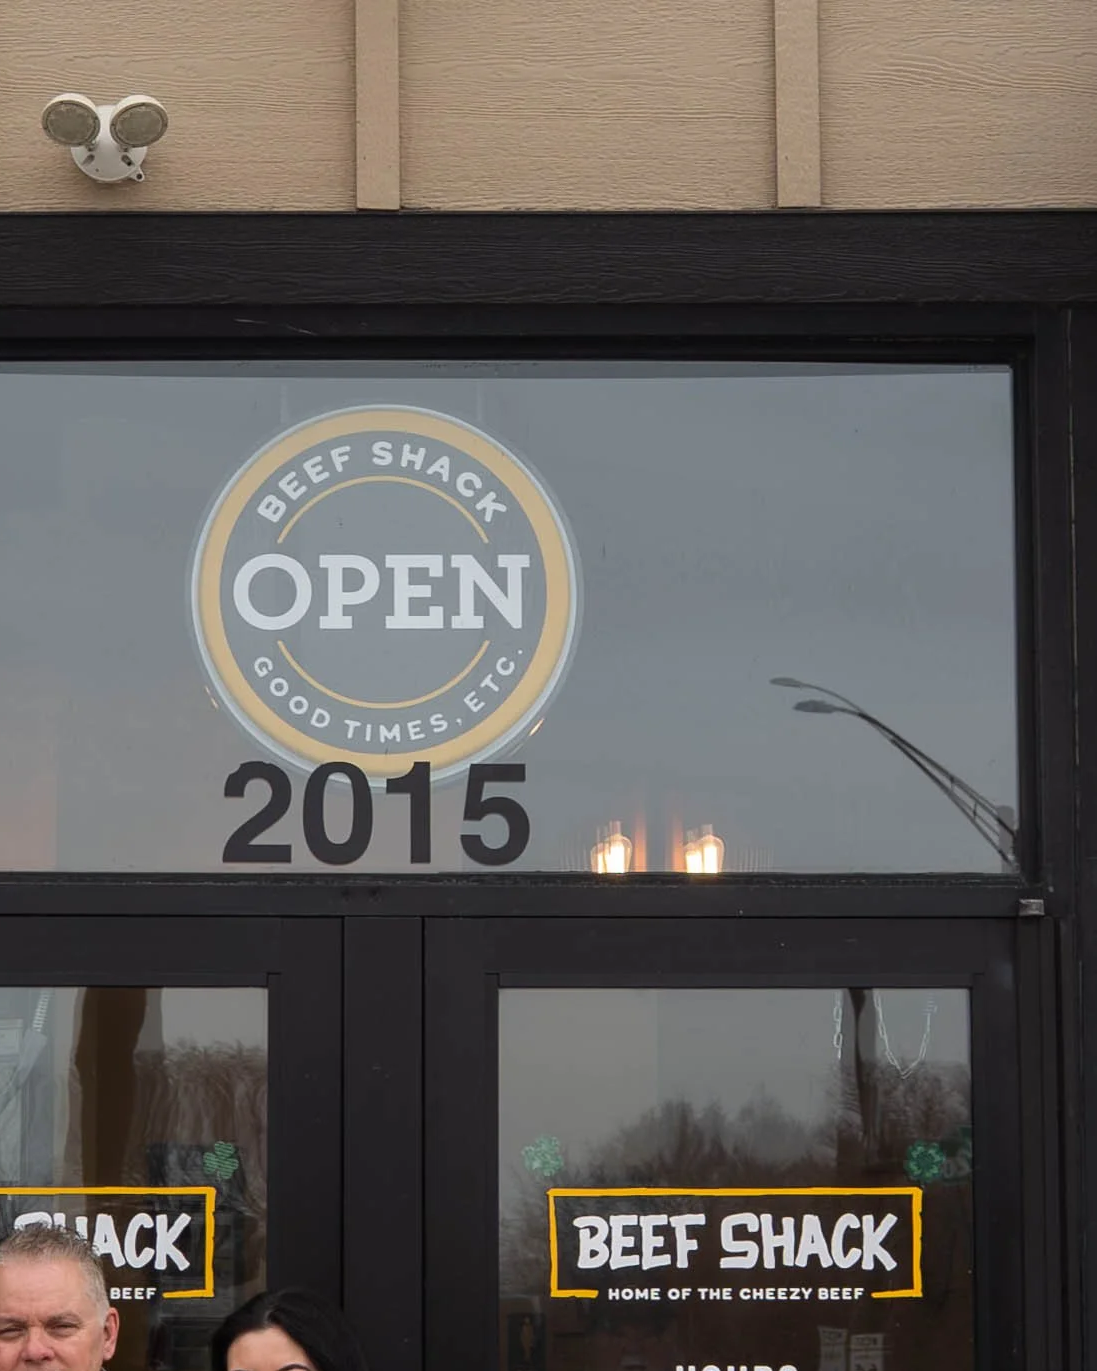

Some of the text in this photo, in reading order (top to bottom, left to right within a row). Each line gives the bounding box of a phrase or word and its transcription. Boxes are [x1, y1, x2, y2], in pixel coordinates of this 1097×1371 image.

[256, 441, 508, 523] BEEF SHACK
[233, 553, 531, 631] OPEN
[253, 647, 524, 744] GOOD TIMES, ETC.
[222, 760, 531, 866] 2015
[573, 1212, 898, 1271] BEEF SHACK
[110, 1286, 158, 1299] BEEF
[608, 1287, 865, 1300] HOME OF THE CHEEZY BEEF
